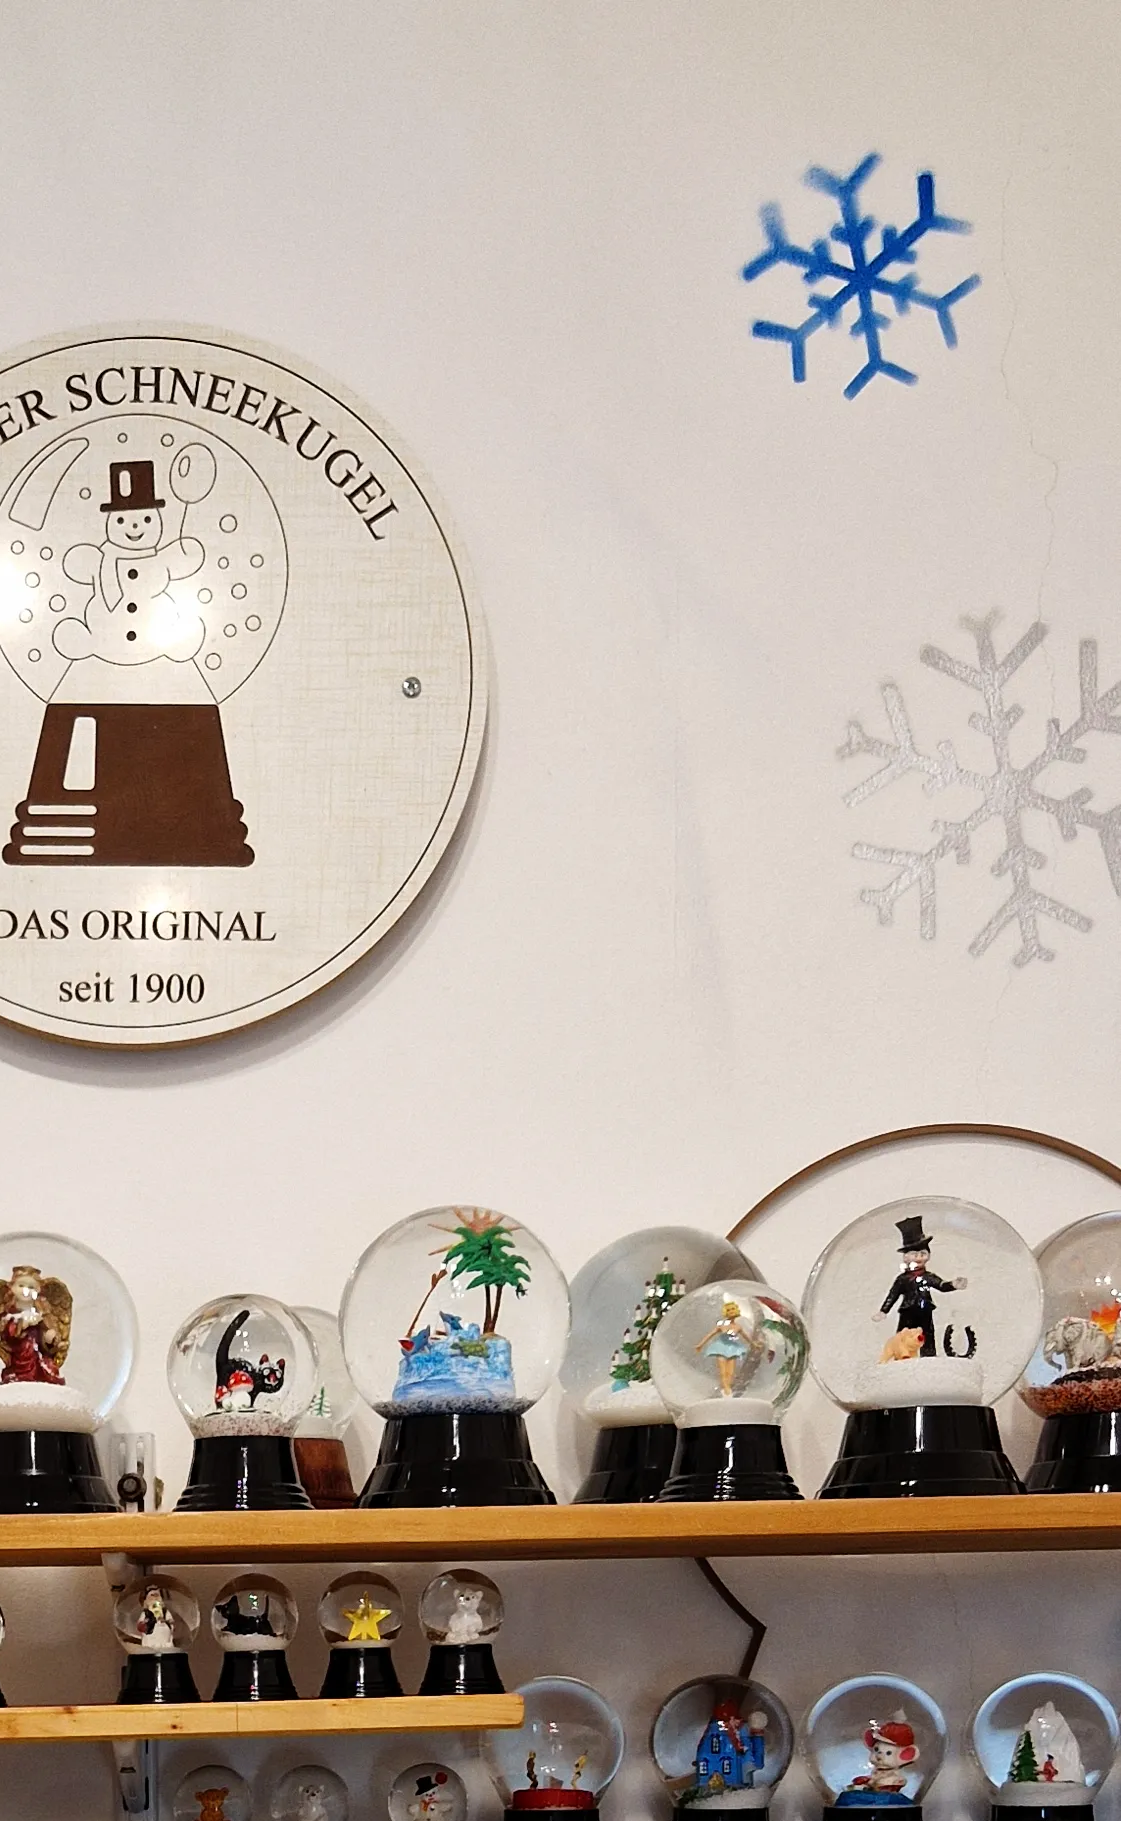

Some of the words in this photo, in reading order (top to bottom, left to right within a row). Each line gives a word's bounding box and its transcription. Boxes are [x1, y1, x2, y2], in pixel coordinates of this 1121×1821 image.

[65, 366, 400, 541] SCHNEEKUGEL
[81, 909, 277, 942] ORIGINAL
[59, 972, 114, 1004] seit
[129, 973, 206, 1005] 1900
